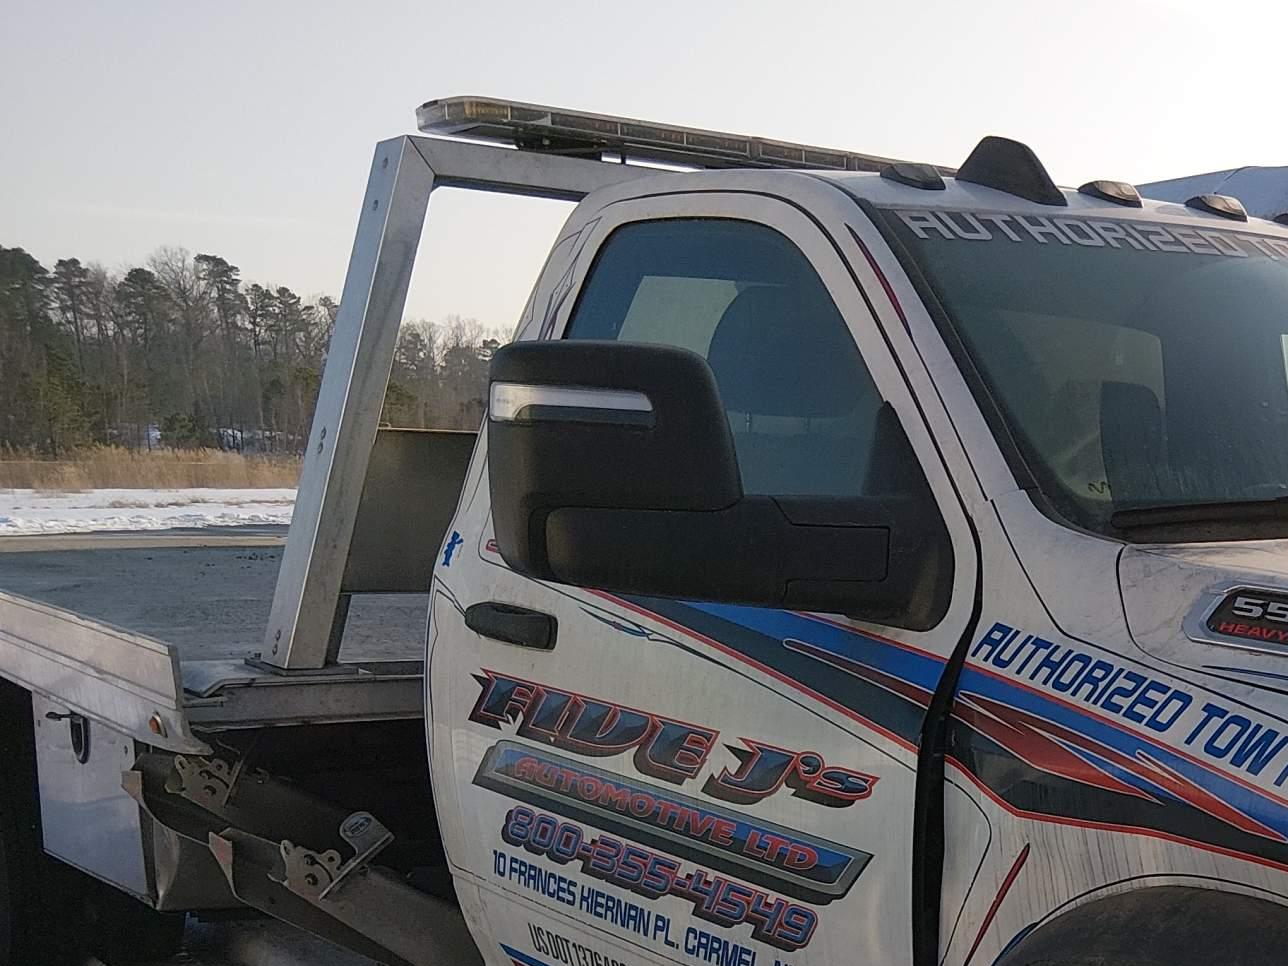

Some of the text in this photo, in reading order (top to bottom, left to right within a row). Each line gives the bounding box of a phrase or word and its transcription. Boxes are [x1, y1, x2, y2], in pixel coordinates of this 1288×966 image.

[894, 209, 1249, 258] AUTHORIZED
[970, 622, 1194, 733] AUTHORIZED
[468, 667, 881, 808] FIVE J's
[514, 756, 819, 870] AUTOMOTIVE LTD
[493, 849, 507, 877] 10
[509, 856, 578, 907] FRANCES
[579, 885, 651, 938] KIERNAN
[653, 914, 680, 950] PL.
[501, 805, 818, 952] 800-355-4549
